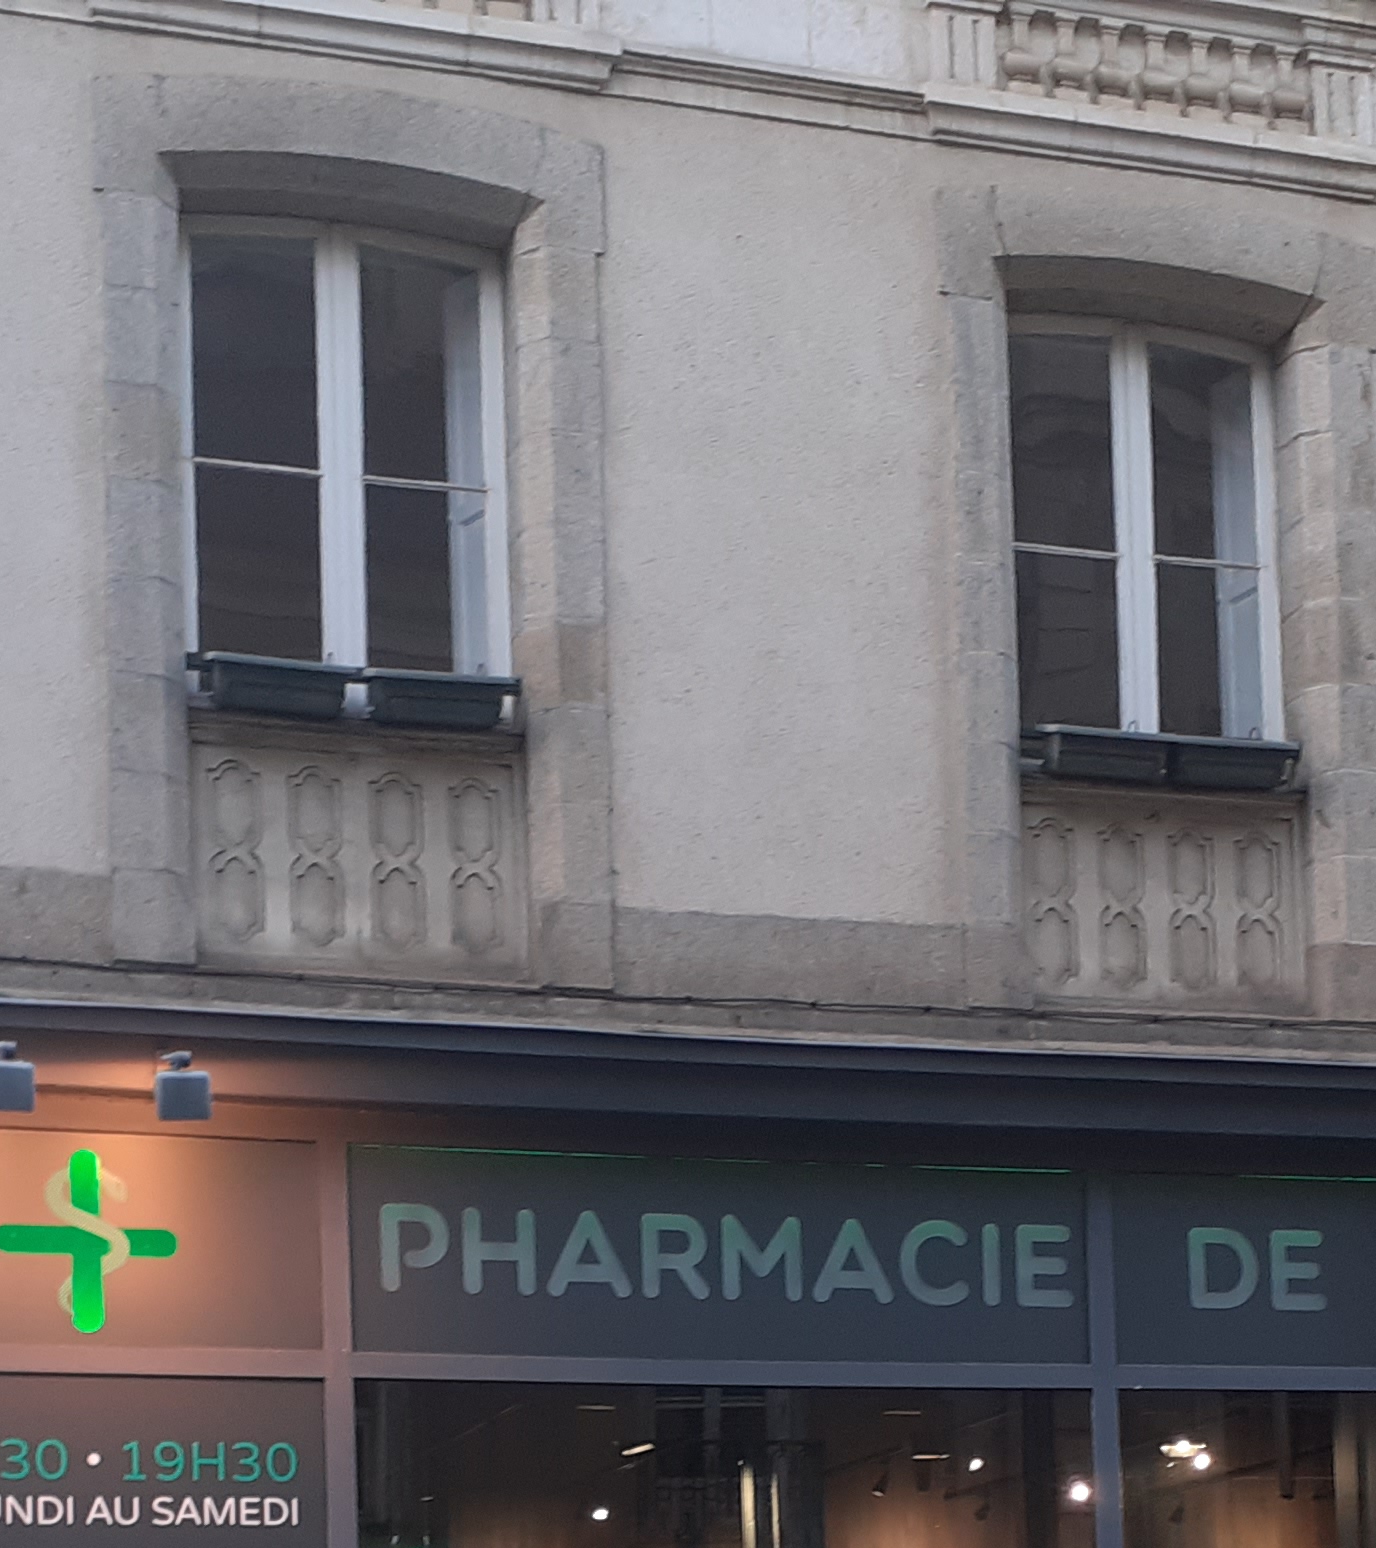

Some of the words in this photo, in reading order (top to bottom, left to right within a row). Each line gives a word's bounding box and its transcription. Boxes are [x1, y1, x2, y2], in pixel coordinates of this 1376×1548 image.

[379, 1202, 1074, 1309] PHARMACIE
[1187, 1226, 1327, 1312] DE
[122, 1440, 300, 1483] 19H30
[85, 1496, 141, 1527] AU
[151, 1496, 301, 1527] SAMEDI
